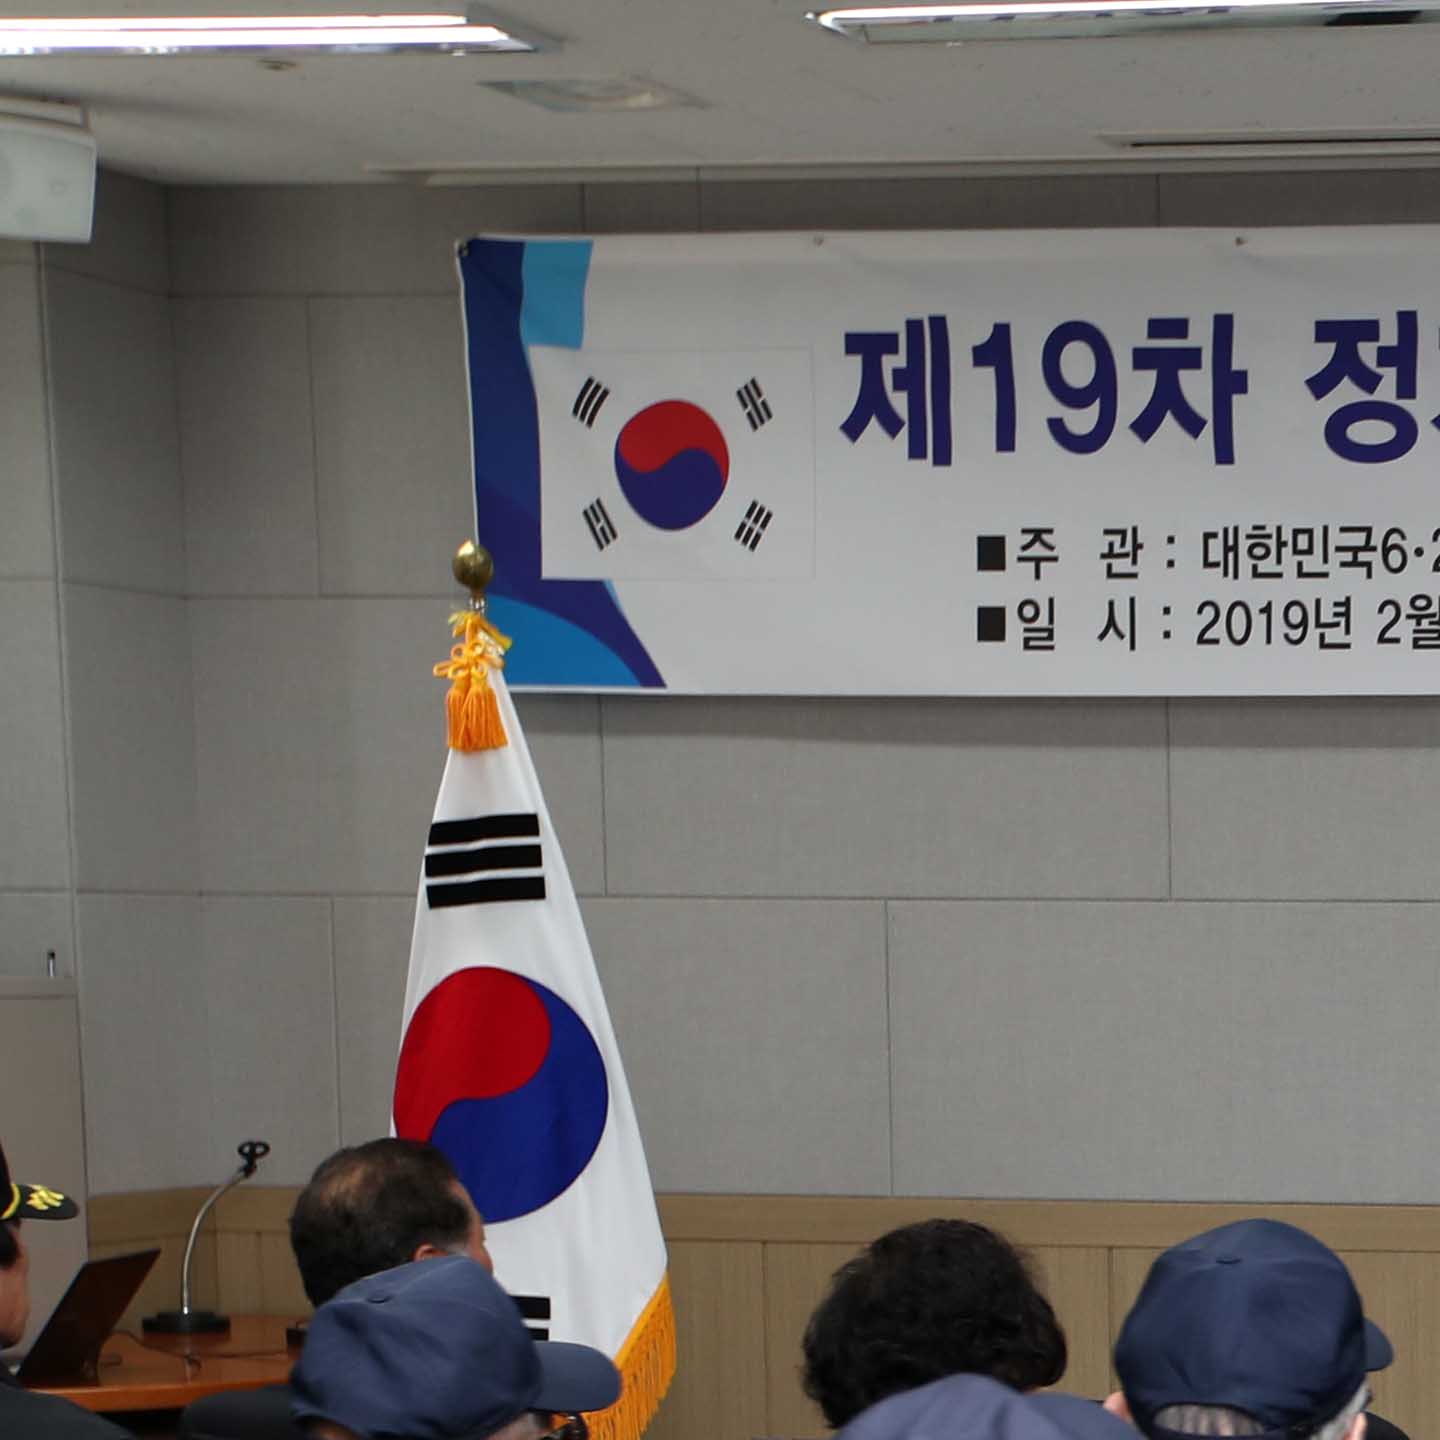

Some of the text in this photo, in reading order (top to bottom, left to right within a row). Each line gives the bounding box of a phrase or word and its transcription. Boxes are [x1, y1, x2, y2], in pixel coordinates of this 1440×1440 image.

[840, 314, 1248, 466] 제19차
[1100, 525, 1144, 579] 관
[1097, 596, 1138, 651] 시
[1196, 596, 1352, 649] 2019년
